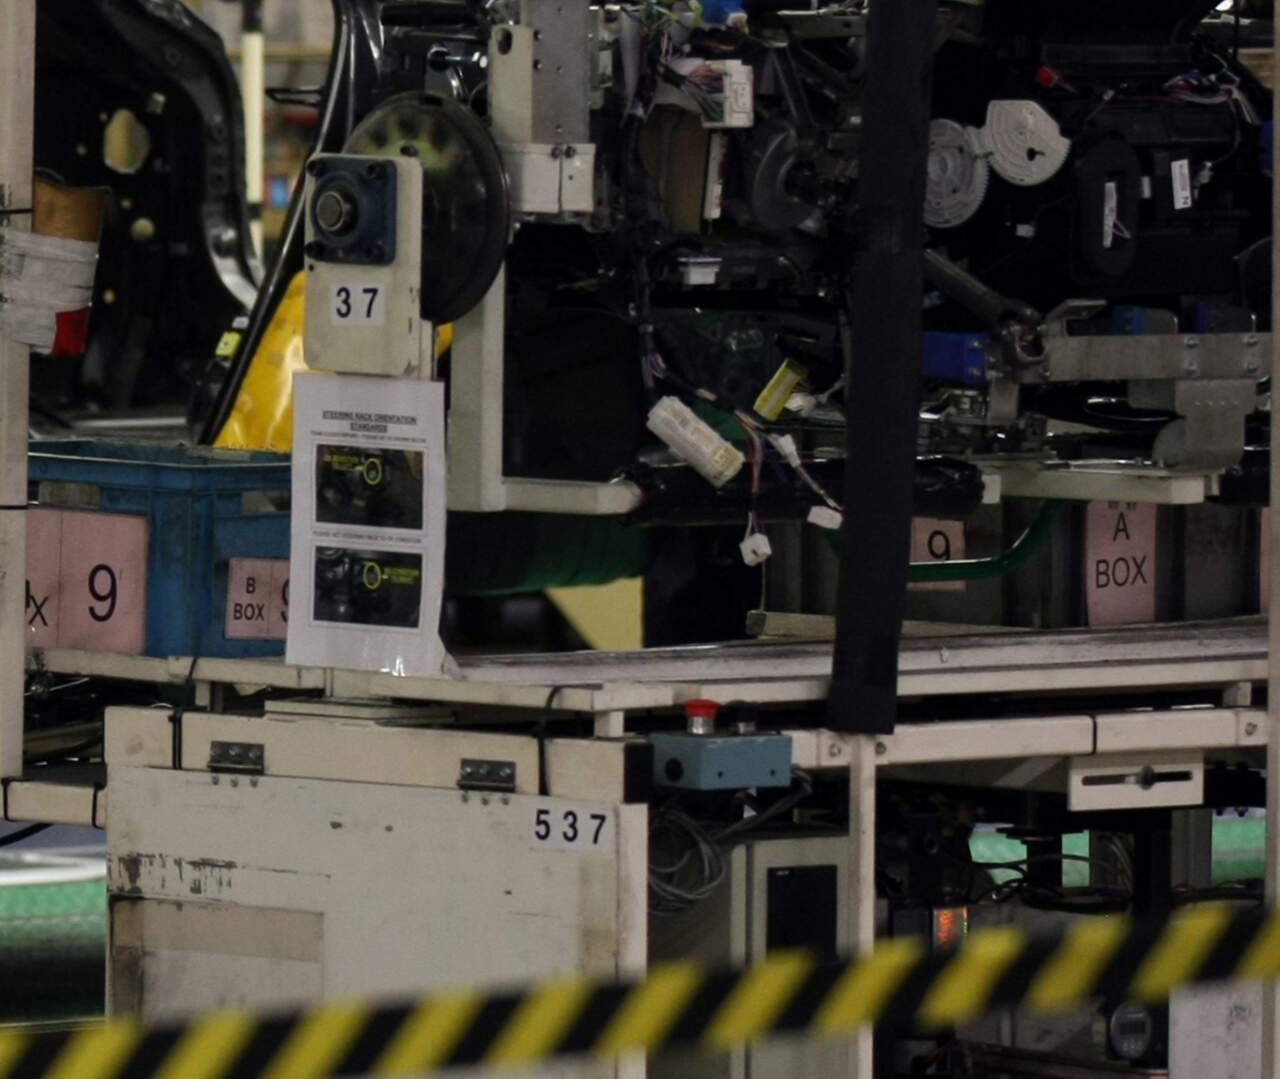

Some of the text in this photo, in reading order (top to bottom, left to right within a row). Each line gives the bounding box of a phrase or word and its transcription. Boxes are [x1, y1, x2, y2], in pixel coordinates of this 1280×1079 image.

[336, 286, 379, 318] 37
[1112, 512, 1130, 541] A
[927, 530, 951, 560] 9
[246, 576, 256, 594] B
[1095, 555, 1148, 588] BOX
[88, 563, 117, 622] 9
[233, 603, 265, 621] BOX
[535, 809, 607, 845] 537
